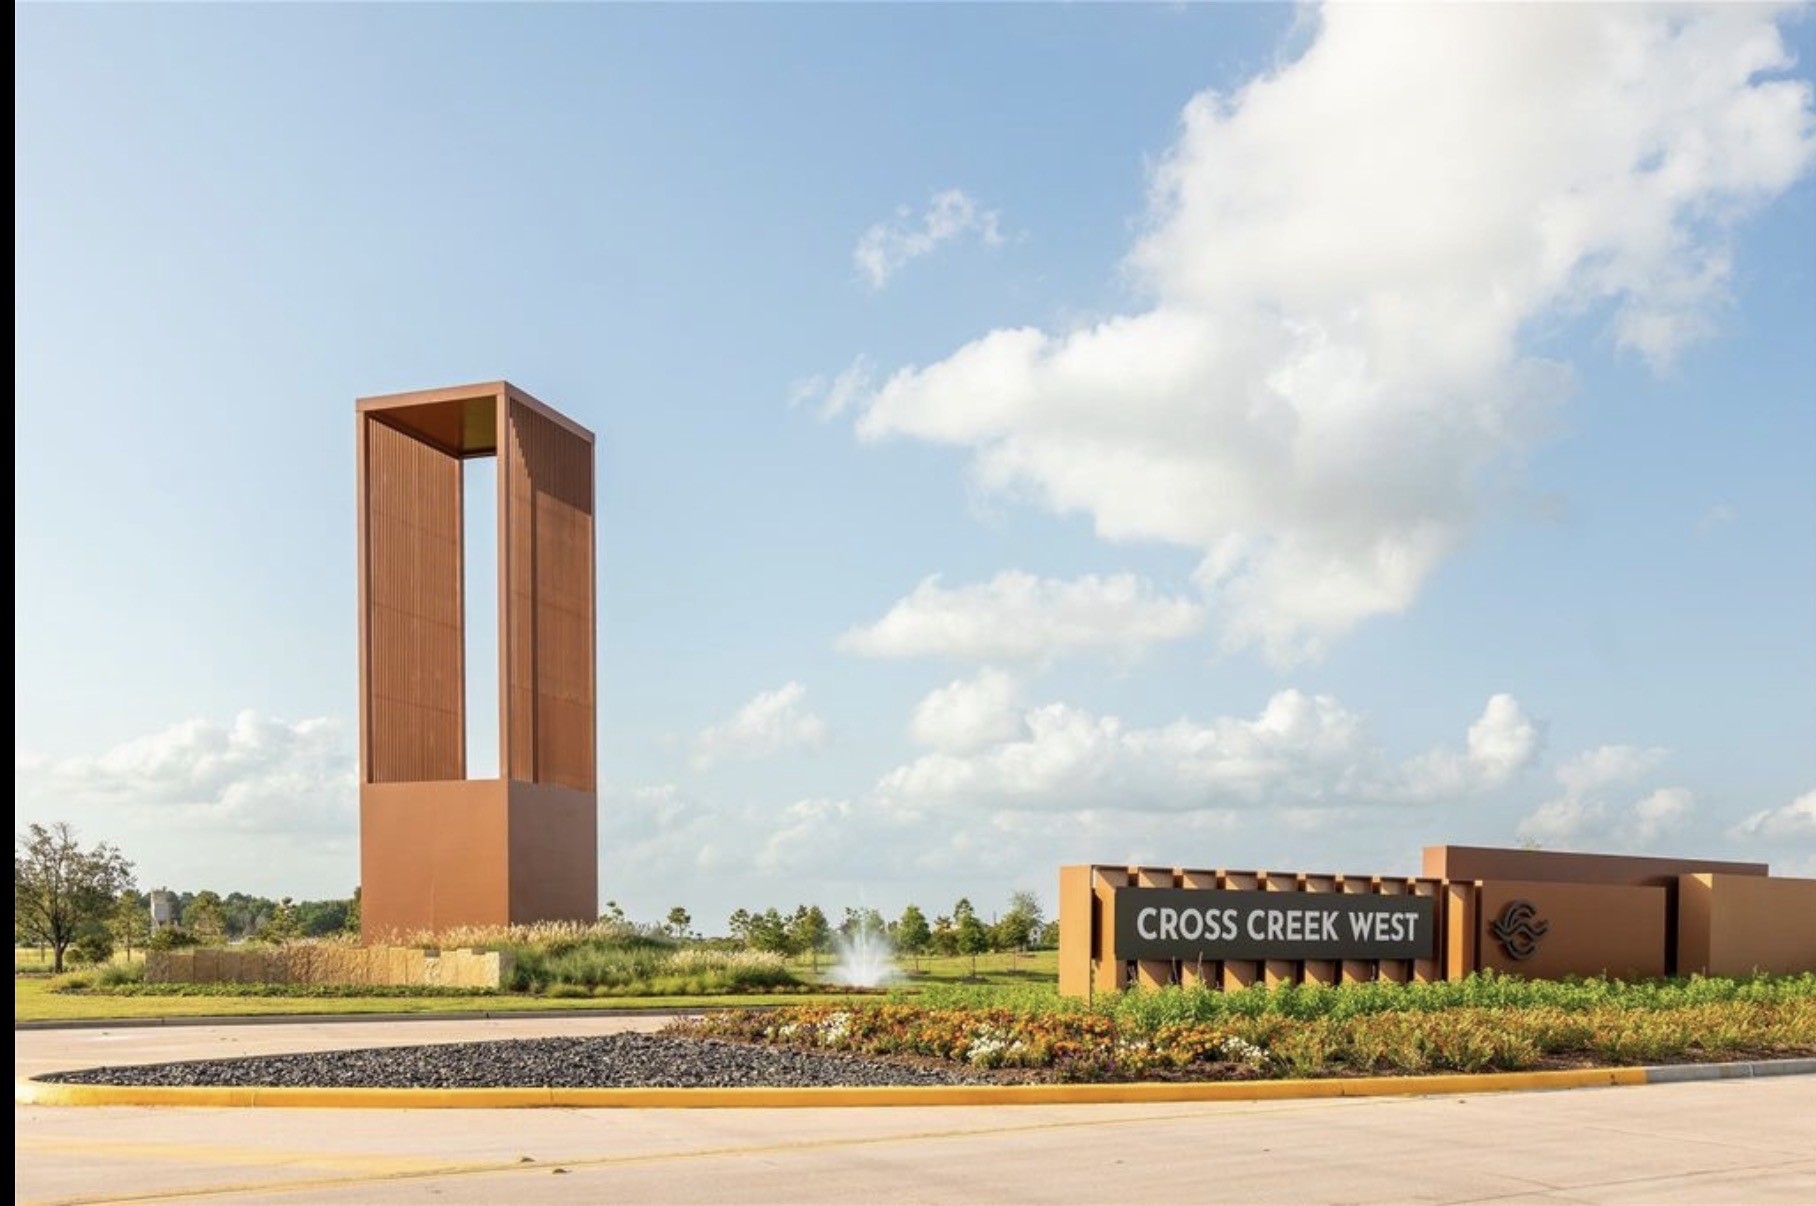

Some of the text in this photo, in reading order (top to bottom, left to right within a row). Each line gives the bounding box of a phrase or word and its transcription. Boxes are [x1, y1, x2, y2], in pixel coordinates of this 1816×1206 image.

[1137, 907, 1419, 942] CROSS CREEK WEST
